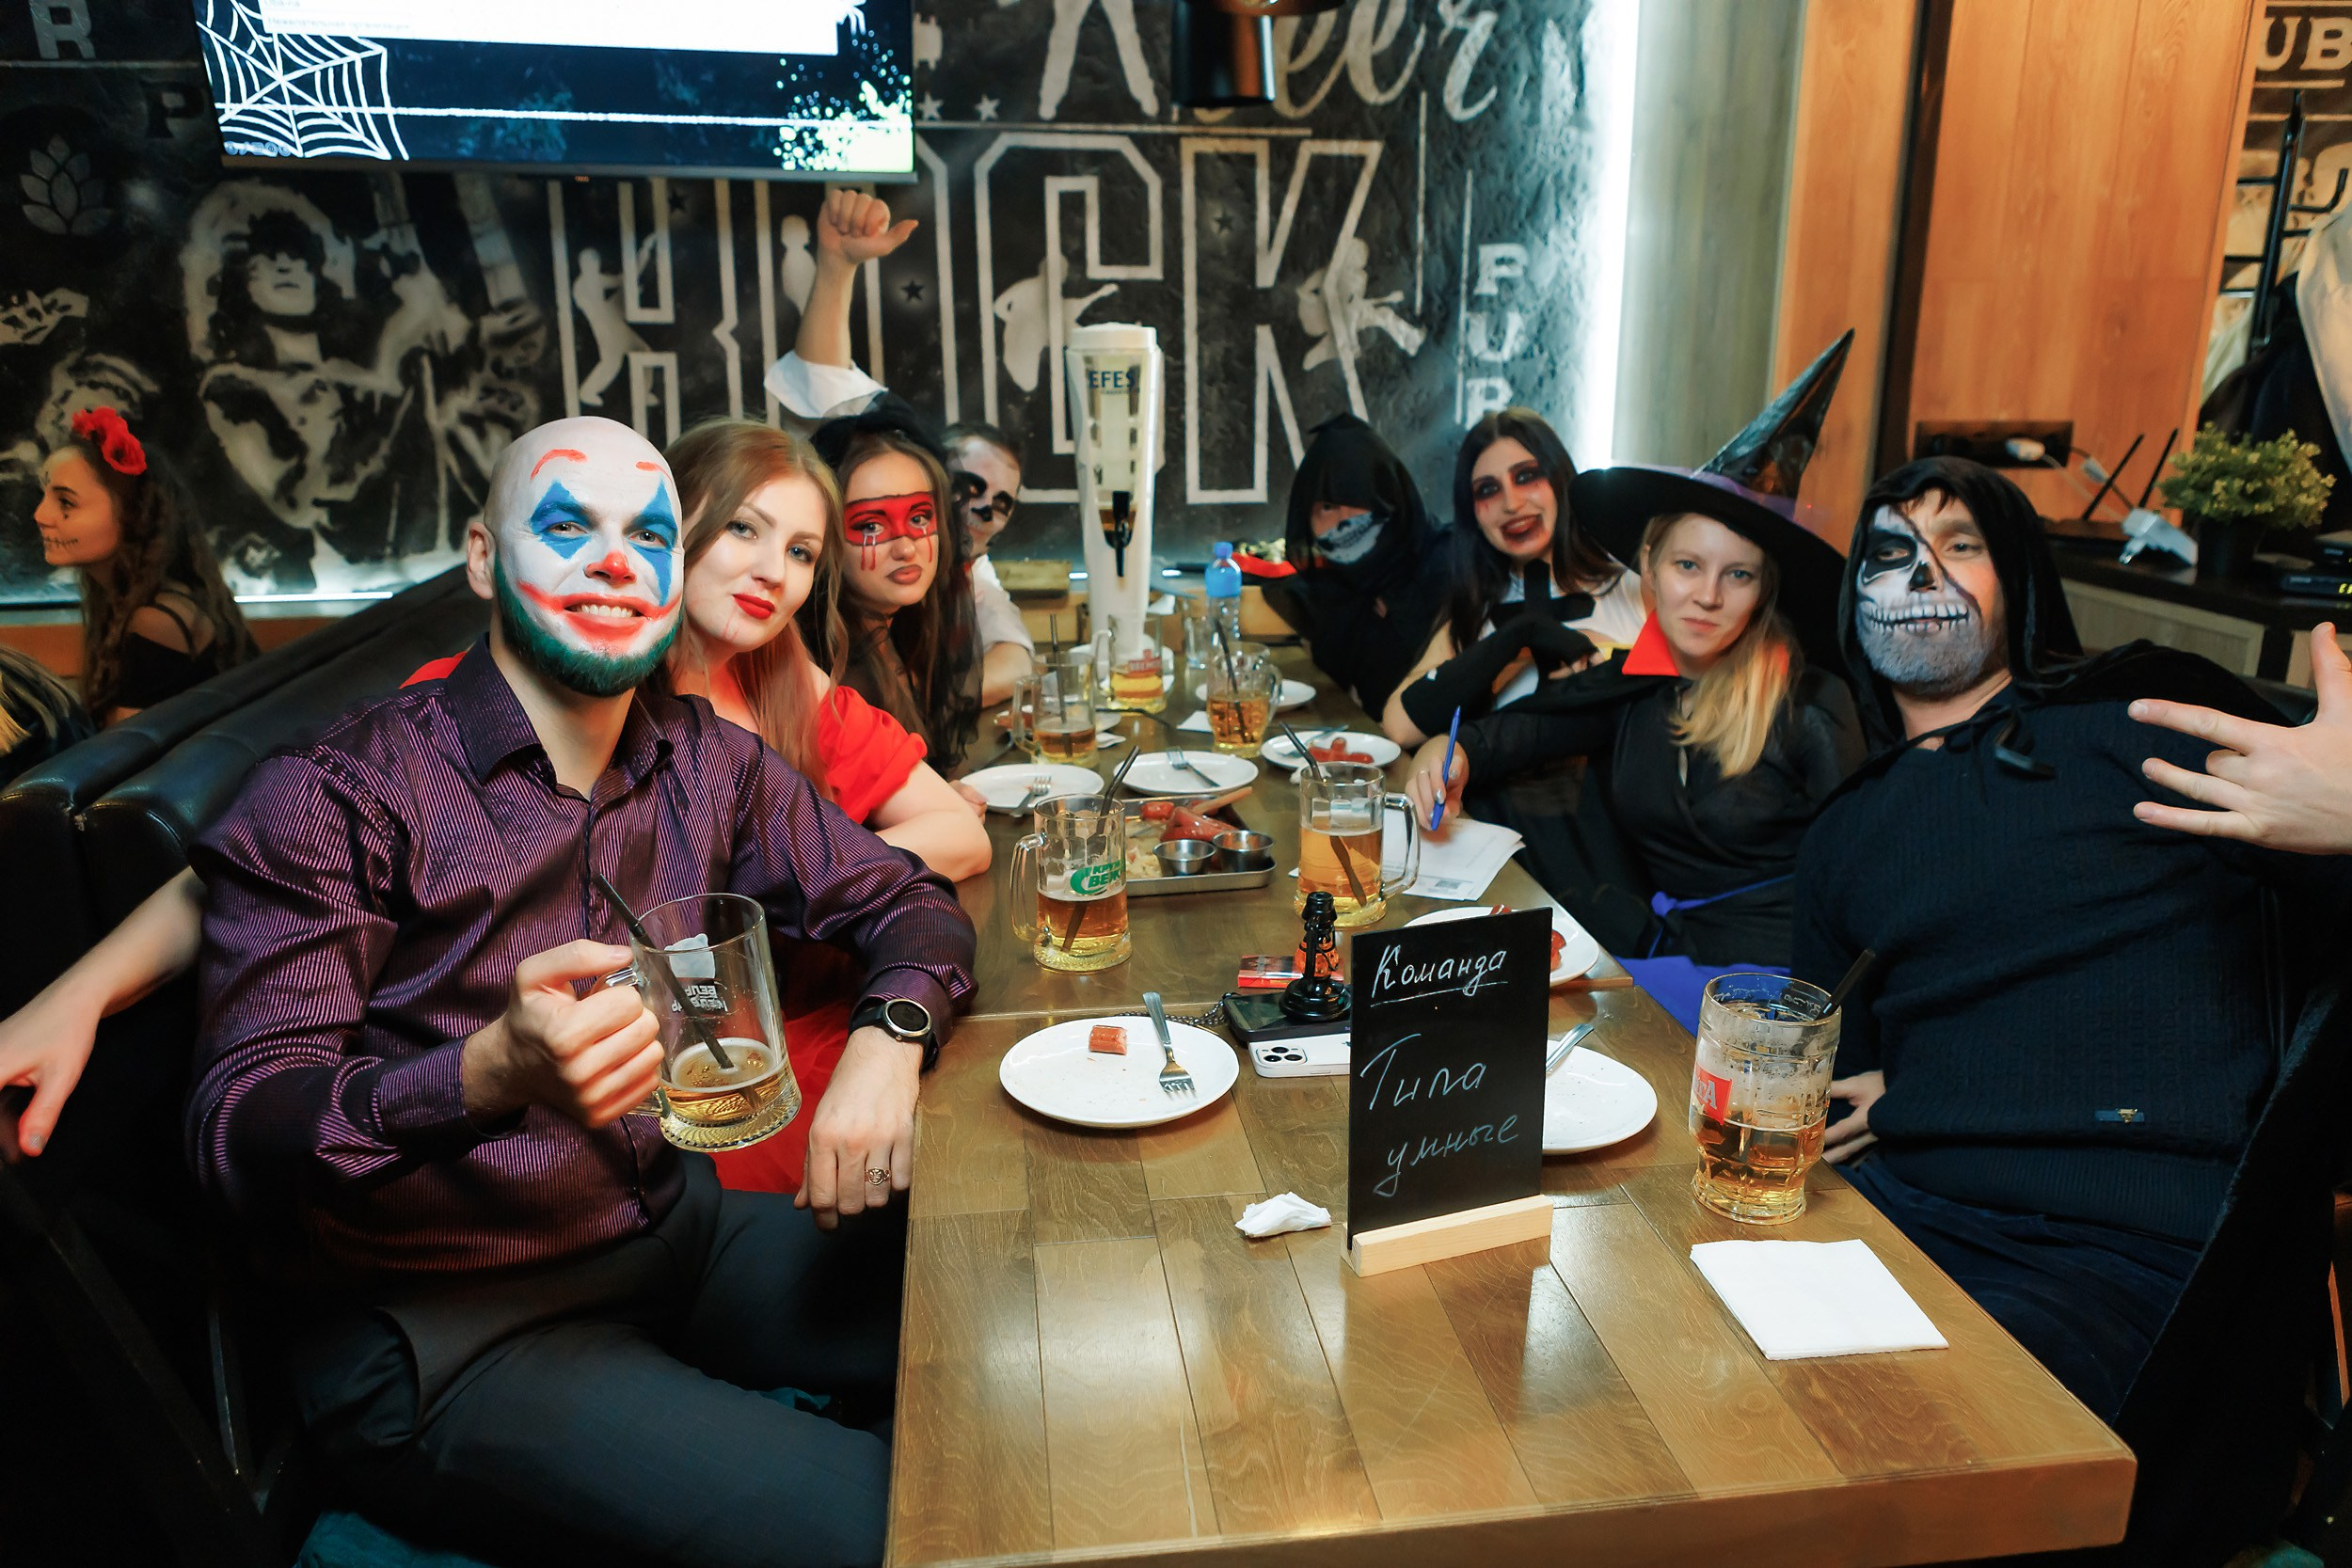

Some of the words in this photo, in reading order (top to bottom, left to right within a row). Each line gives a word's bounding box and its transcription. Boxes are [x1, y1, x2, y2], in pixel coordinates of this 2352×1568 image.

[1193, 0, 1498, 123] eer
[1088, 370, 1136, 390] EFES
[1371, 944, 1507, 998] Команда
[1360, 1033, 1487, 1111] Типа
[1373, 1114, 1519, 1197] умные
